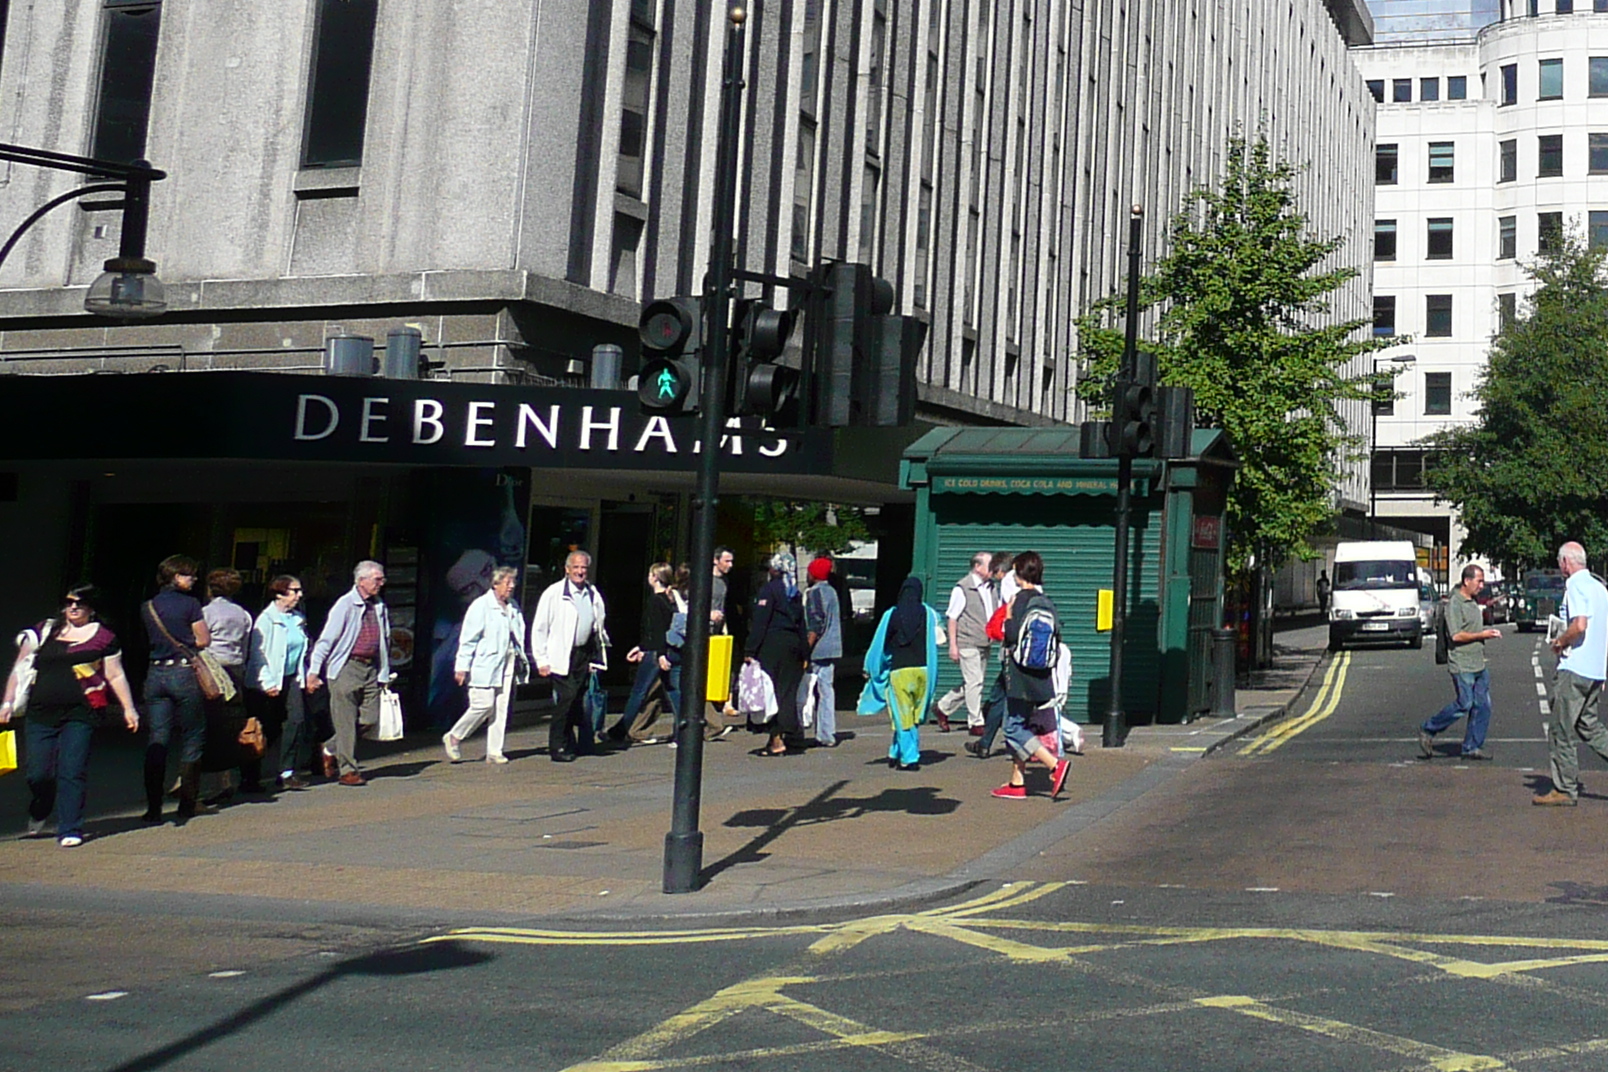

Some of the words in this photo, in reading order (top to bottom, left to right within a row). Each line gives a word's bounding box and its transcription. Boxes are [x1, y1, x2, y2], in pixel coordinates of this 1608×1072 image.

[958, 479, 978, 487] COLD
[1010, 479, 1031, 488] COCA
[1056, 480, 1073, 488] AND
